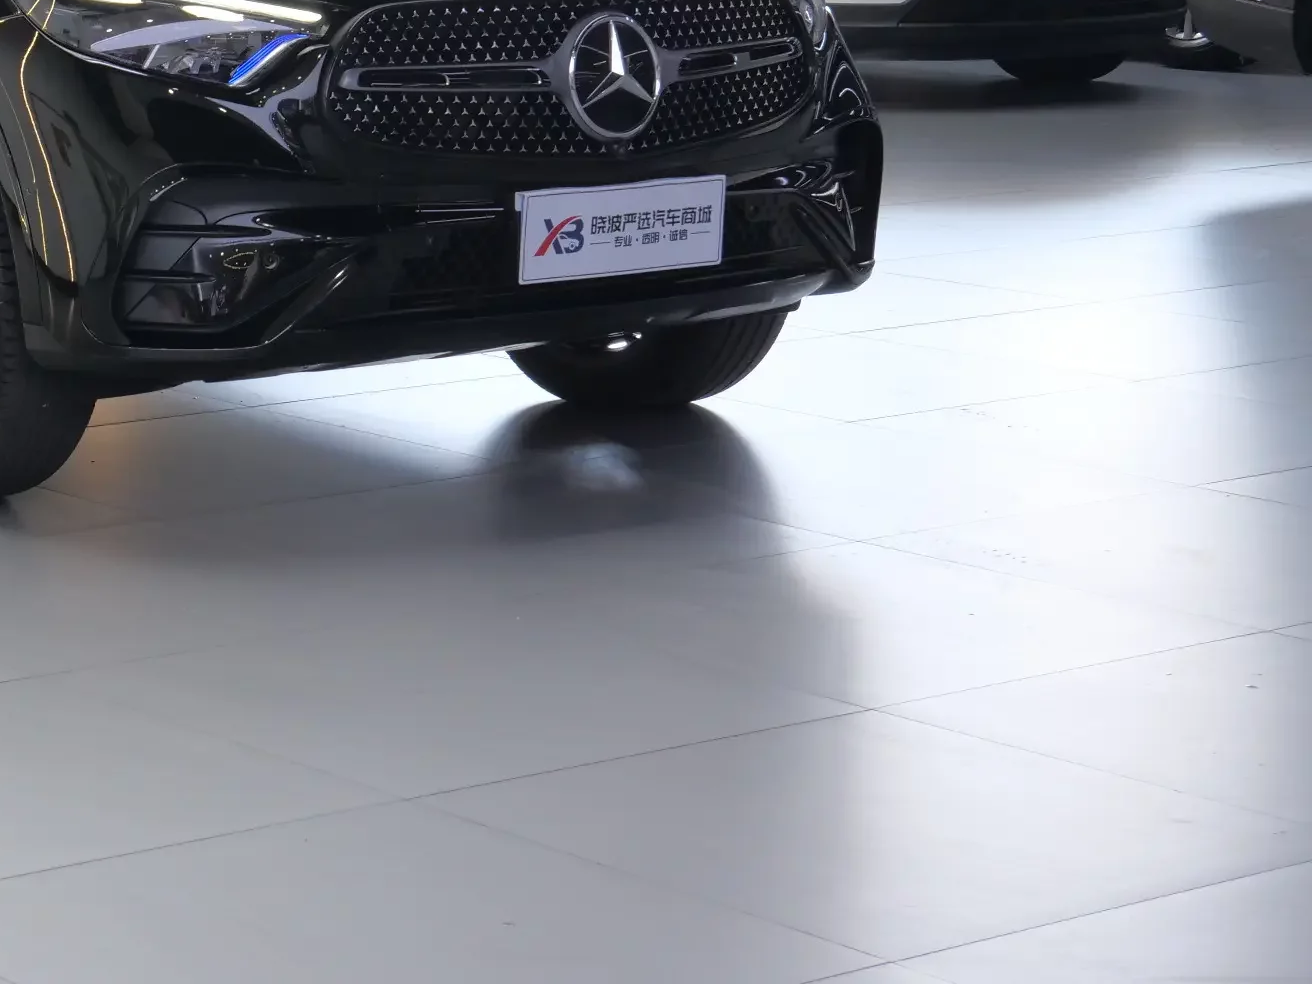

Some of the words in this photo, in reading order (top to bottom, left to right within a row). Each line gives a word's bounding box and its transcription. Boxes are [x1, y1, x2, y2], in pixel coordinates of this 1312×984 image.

[590, 205, 713, 235] 晓波严选汽车商城
